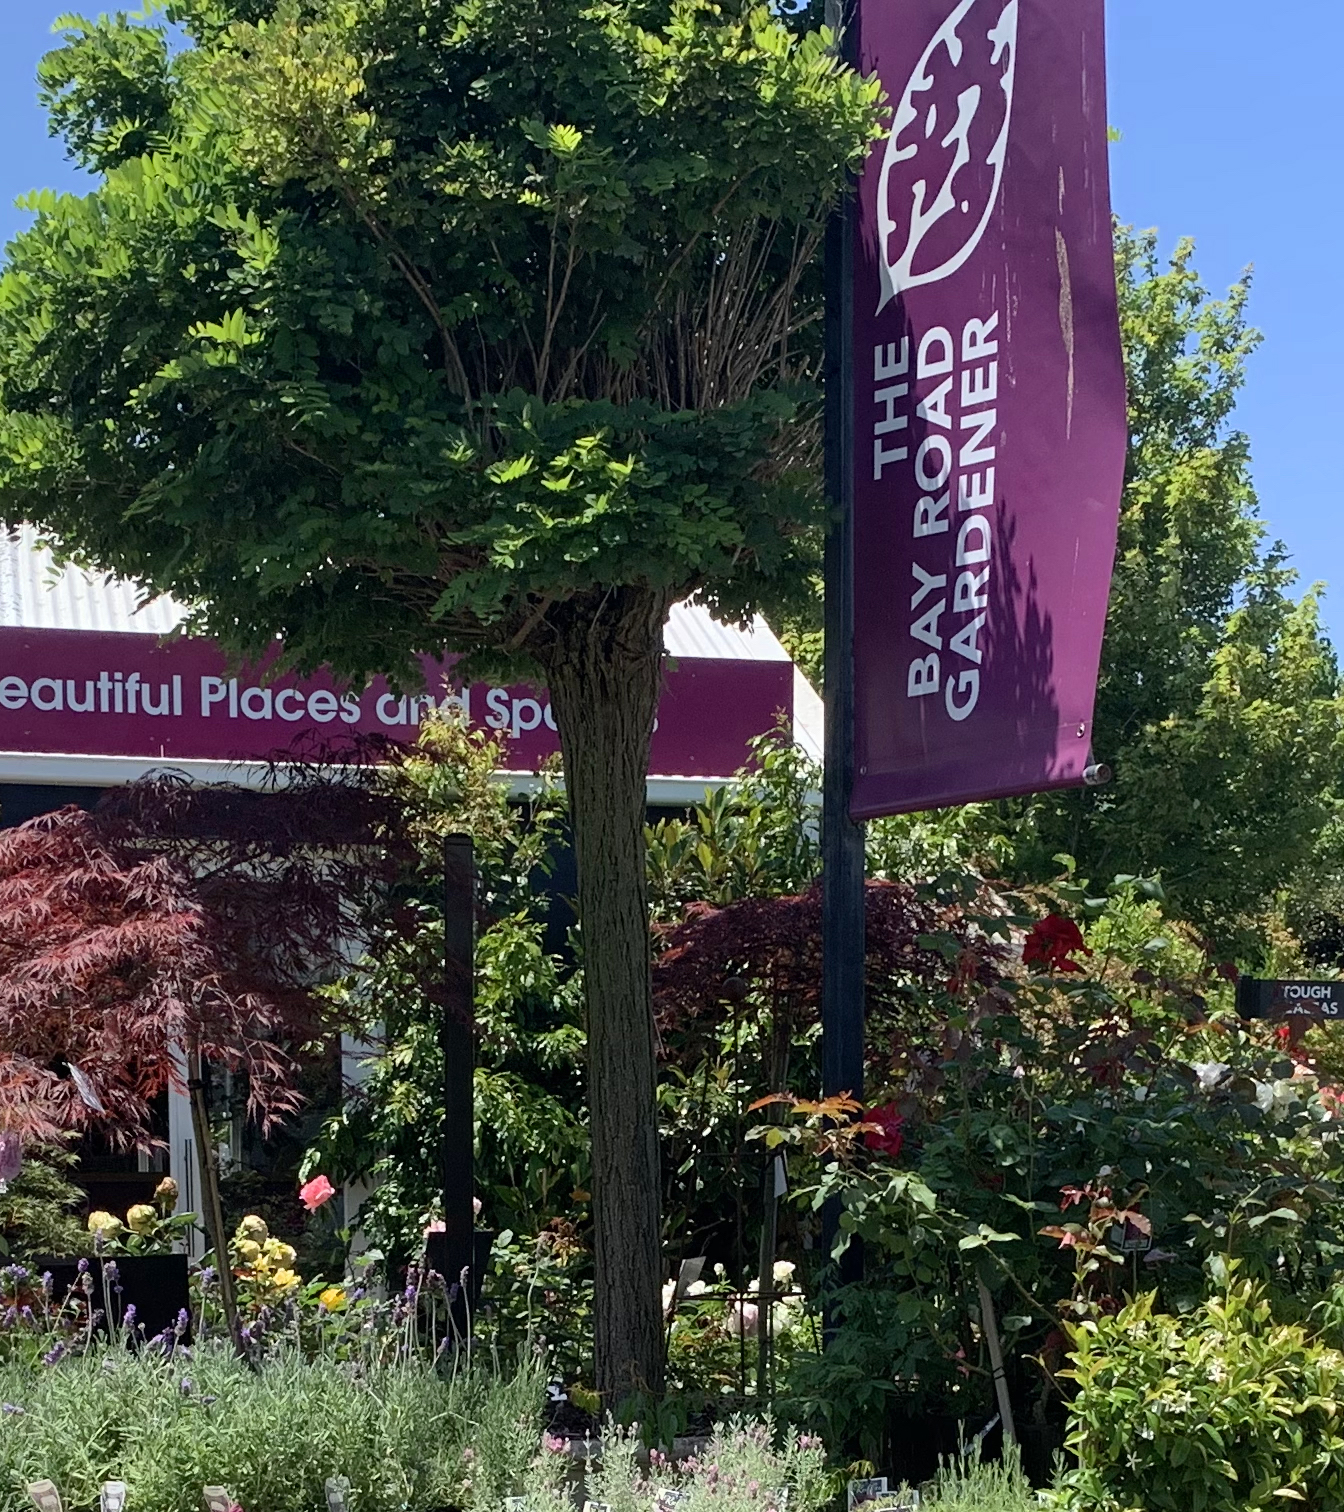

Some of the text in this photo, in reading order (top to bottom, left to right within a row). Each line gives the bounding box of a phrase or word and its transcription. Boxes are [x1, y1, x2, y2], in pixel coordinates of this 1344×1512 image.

[873, 335, 910, 481] THE
[907, 325, 955, 698] BAY ROAD
[945, 309, 999, 722] GARDENER
[200, 676, 362, 724] Places
[375, 686, 470, 726] and
[1282, 985, 1332, 999] TOUGH
